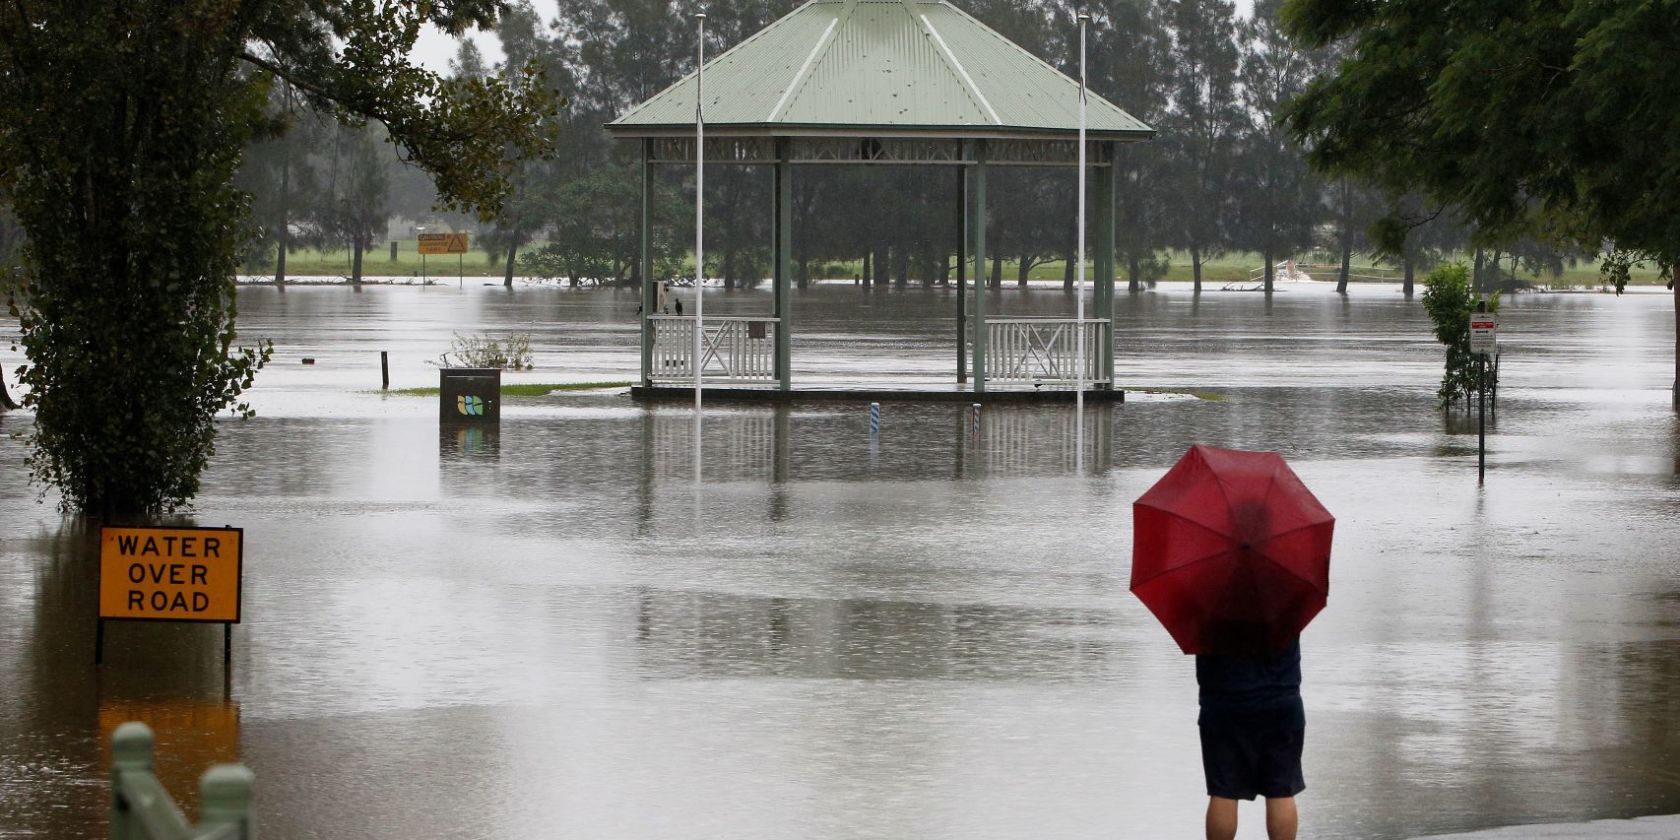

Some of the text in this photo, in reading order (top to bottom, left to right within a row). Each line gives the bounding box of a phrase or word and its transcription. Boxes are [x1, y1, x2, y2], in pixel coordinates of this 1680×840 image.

[118, 535, 220, 557] WATER
[128, 563, 207, 584] OVER
[128, 590, 208, 611] ROAD
